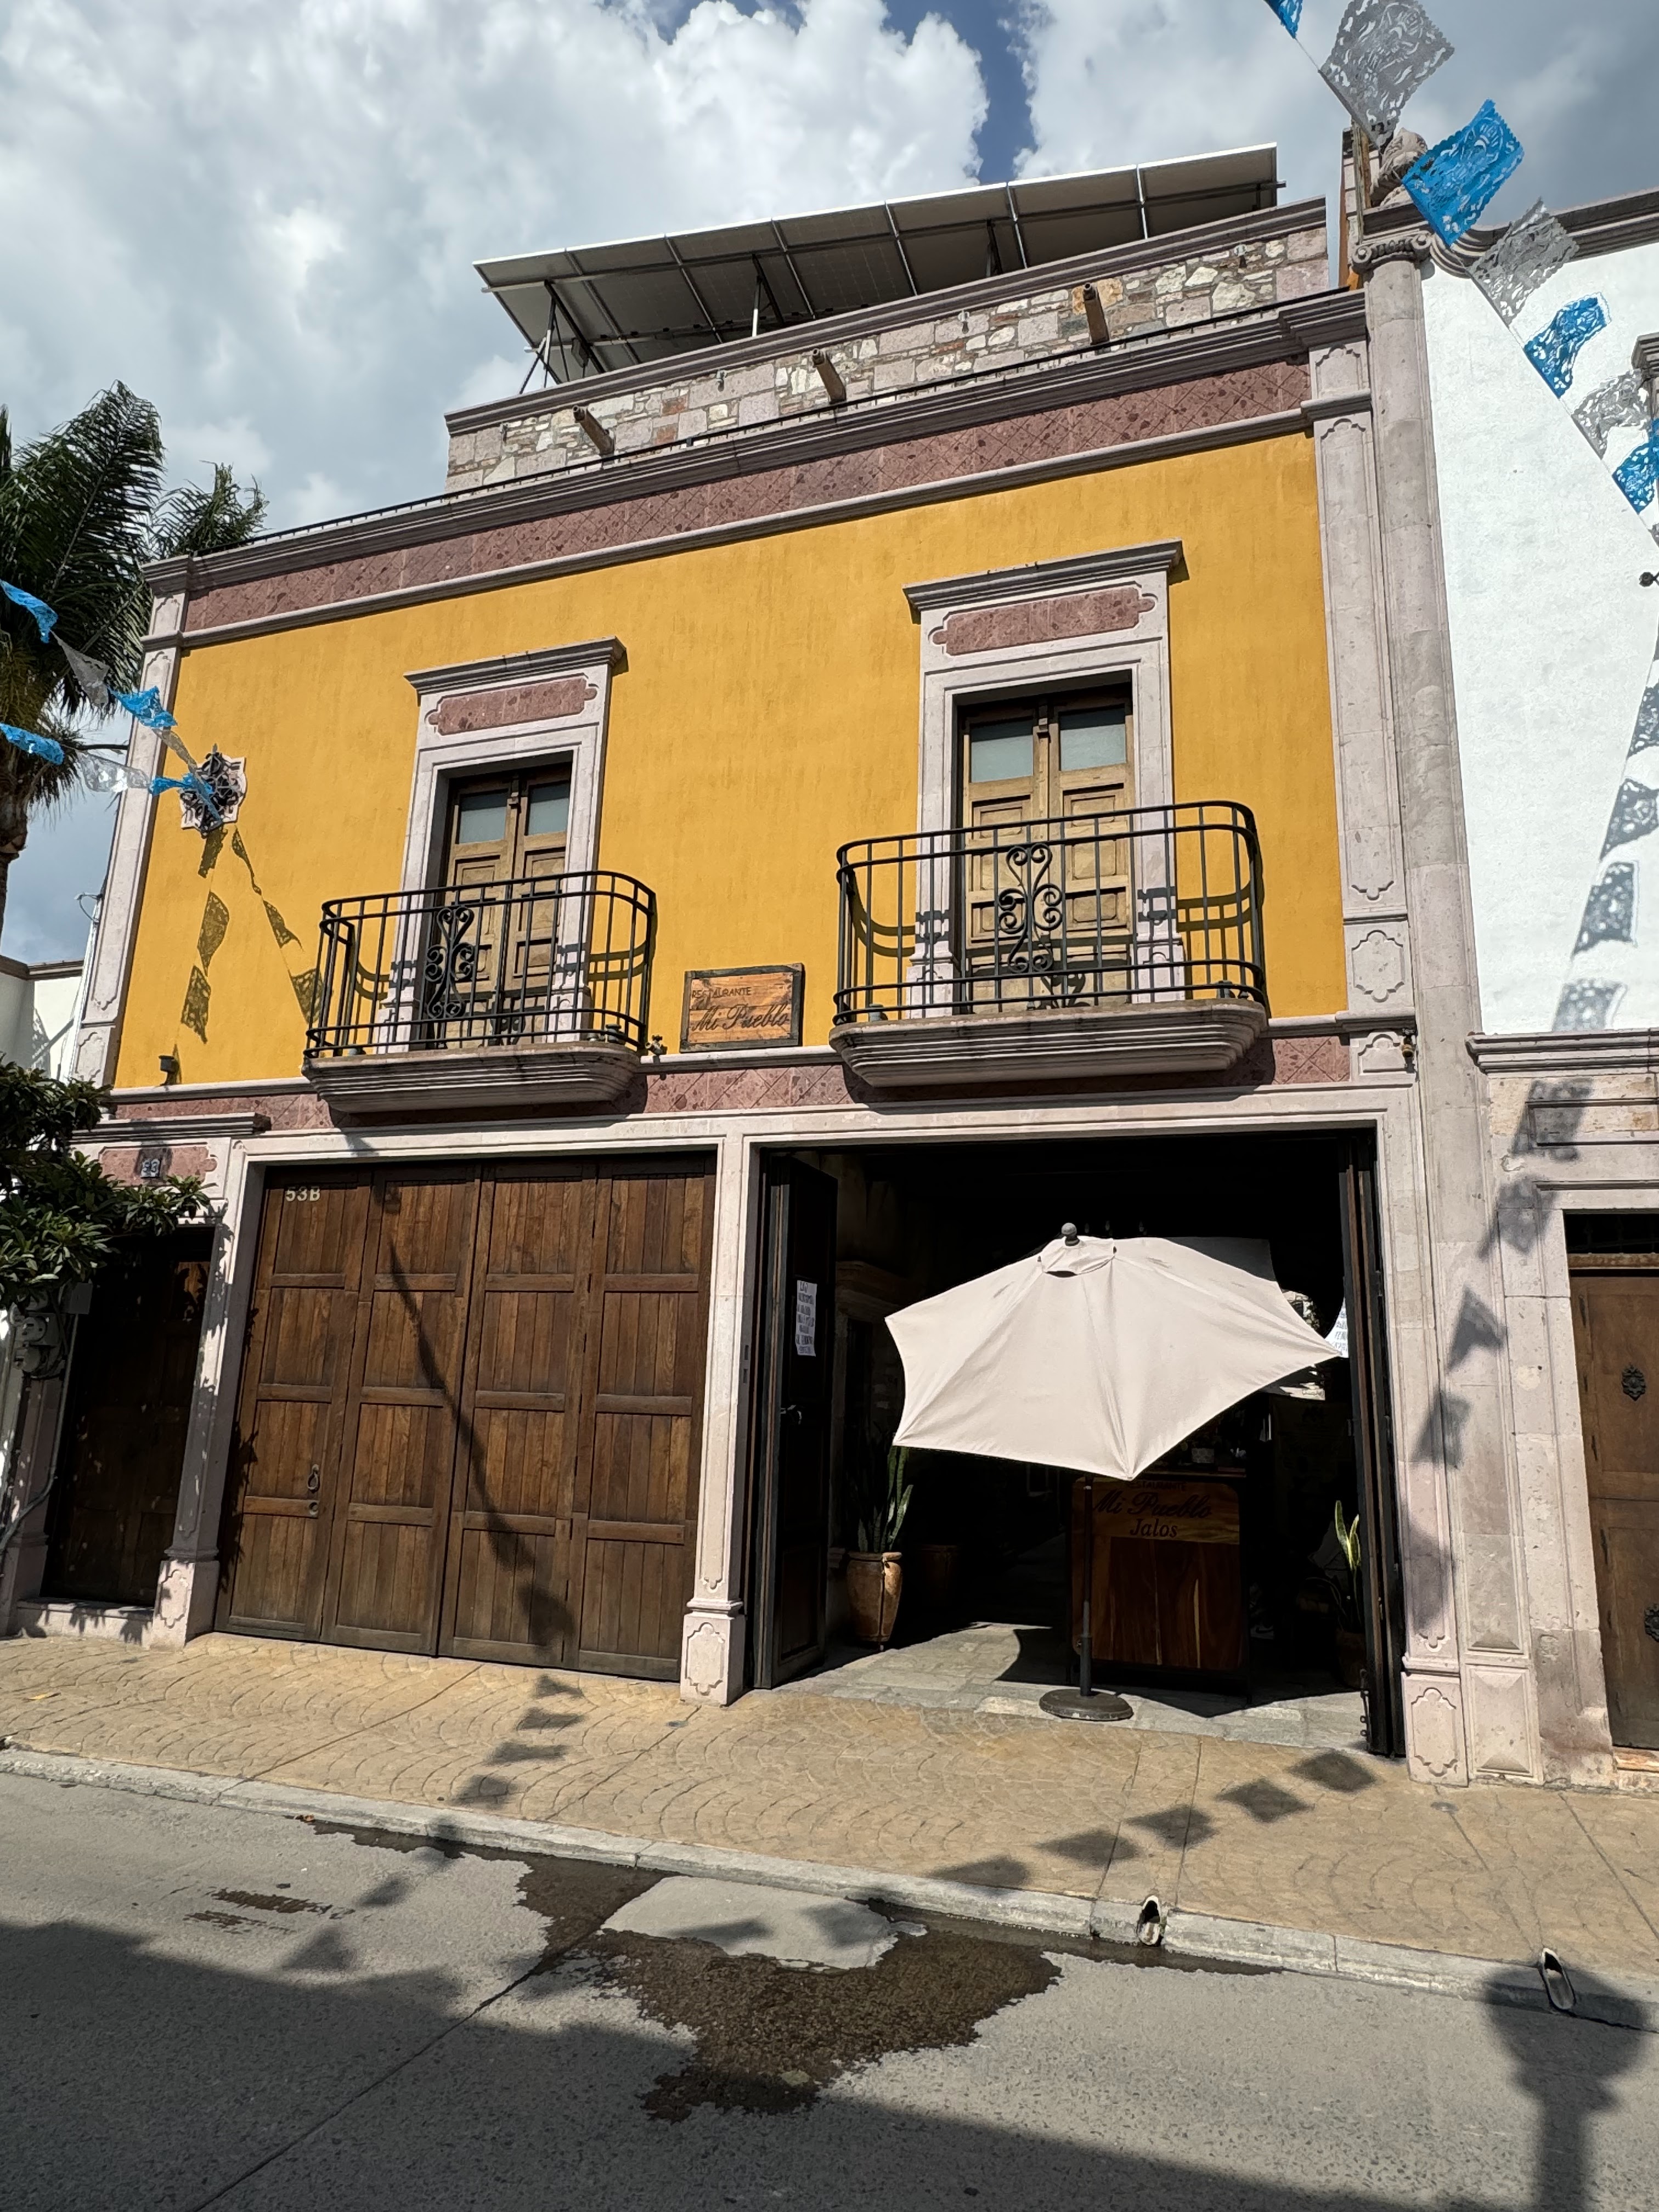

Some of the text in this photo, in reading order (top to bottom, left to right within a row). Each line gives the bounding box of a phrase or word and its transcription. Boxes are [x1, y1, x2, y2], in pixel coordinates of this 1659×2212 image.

[692, 987, 752, 998] RESTAURANTE
[692, 1002, 790, 1031] Mi Pueblo
[285, 1186, 320, 1202] 53B
[1093, 1489, 1212, 1518] Mi Pueblo
[1130, 1518, 1177, 1537] Jalos
